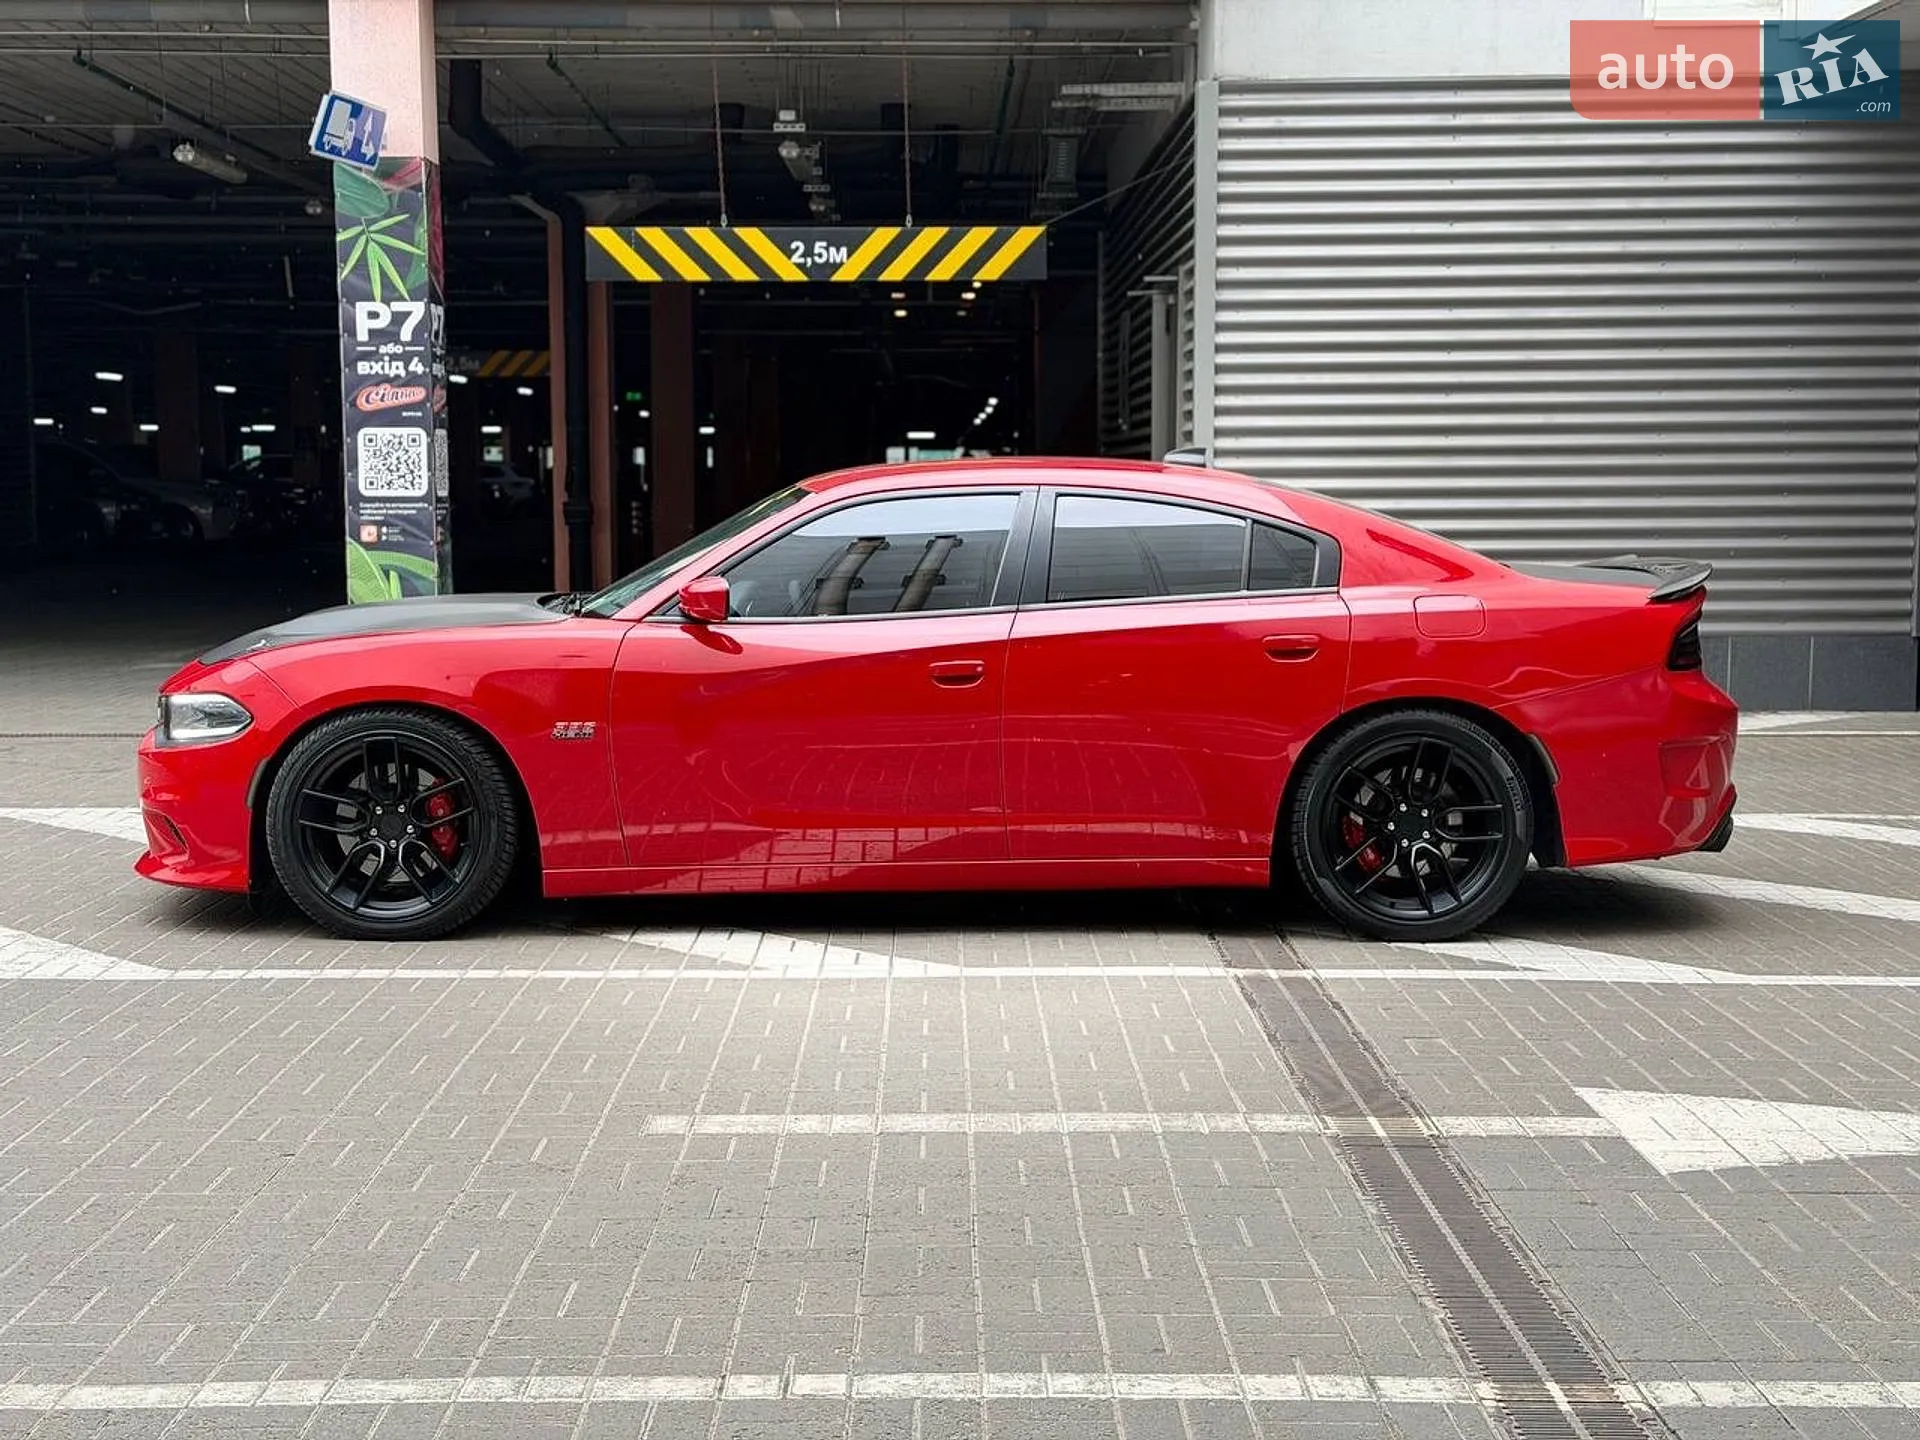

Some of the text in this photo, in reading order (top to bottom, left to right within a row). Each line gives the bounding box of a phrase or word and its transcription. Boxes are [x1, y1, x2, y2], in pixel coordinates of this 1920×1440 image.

[379, 342, 403, 354] або
[357, 355, 406, 378] вхід
[408, 356, 424, 375] 4
